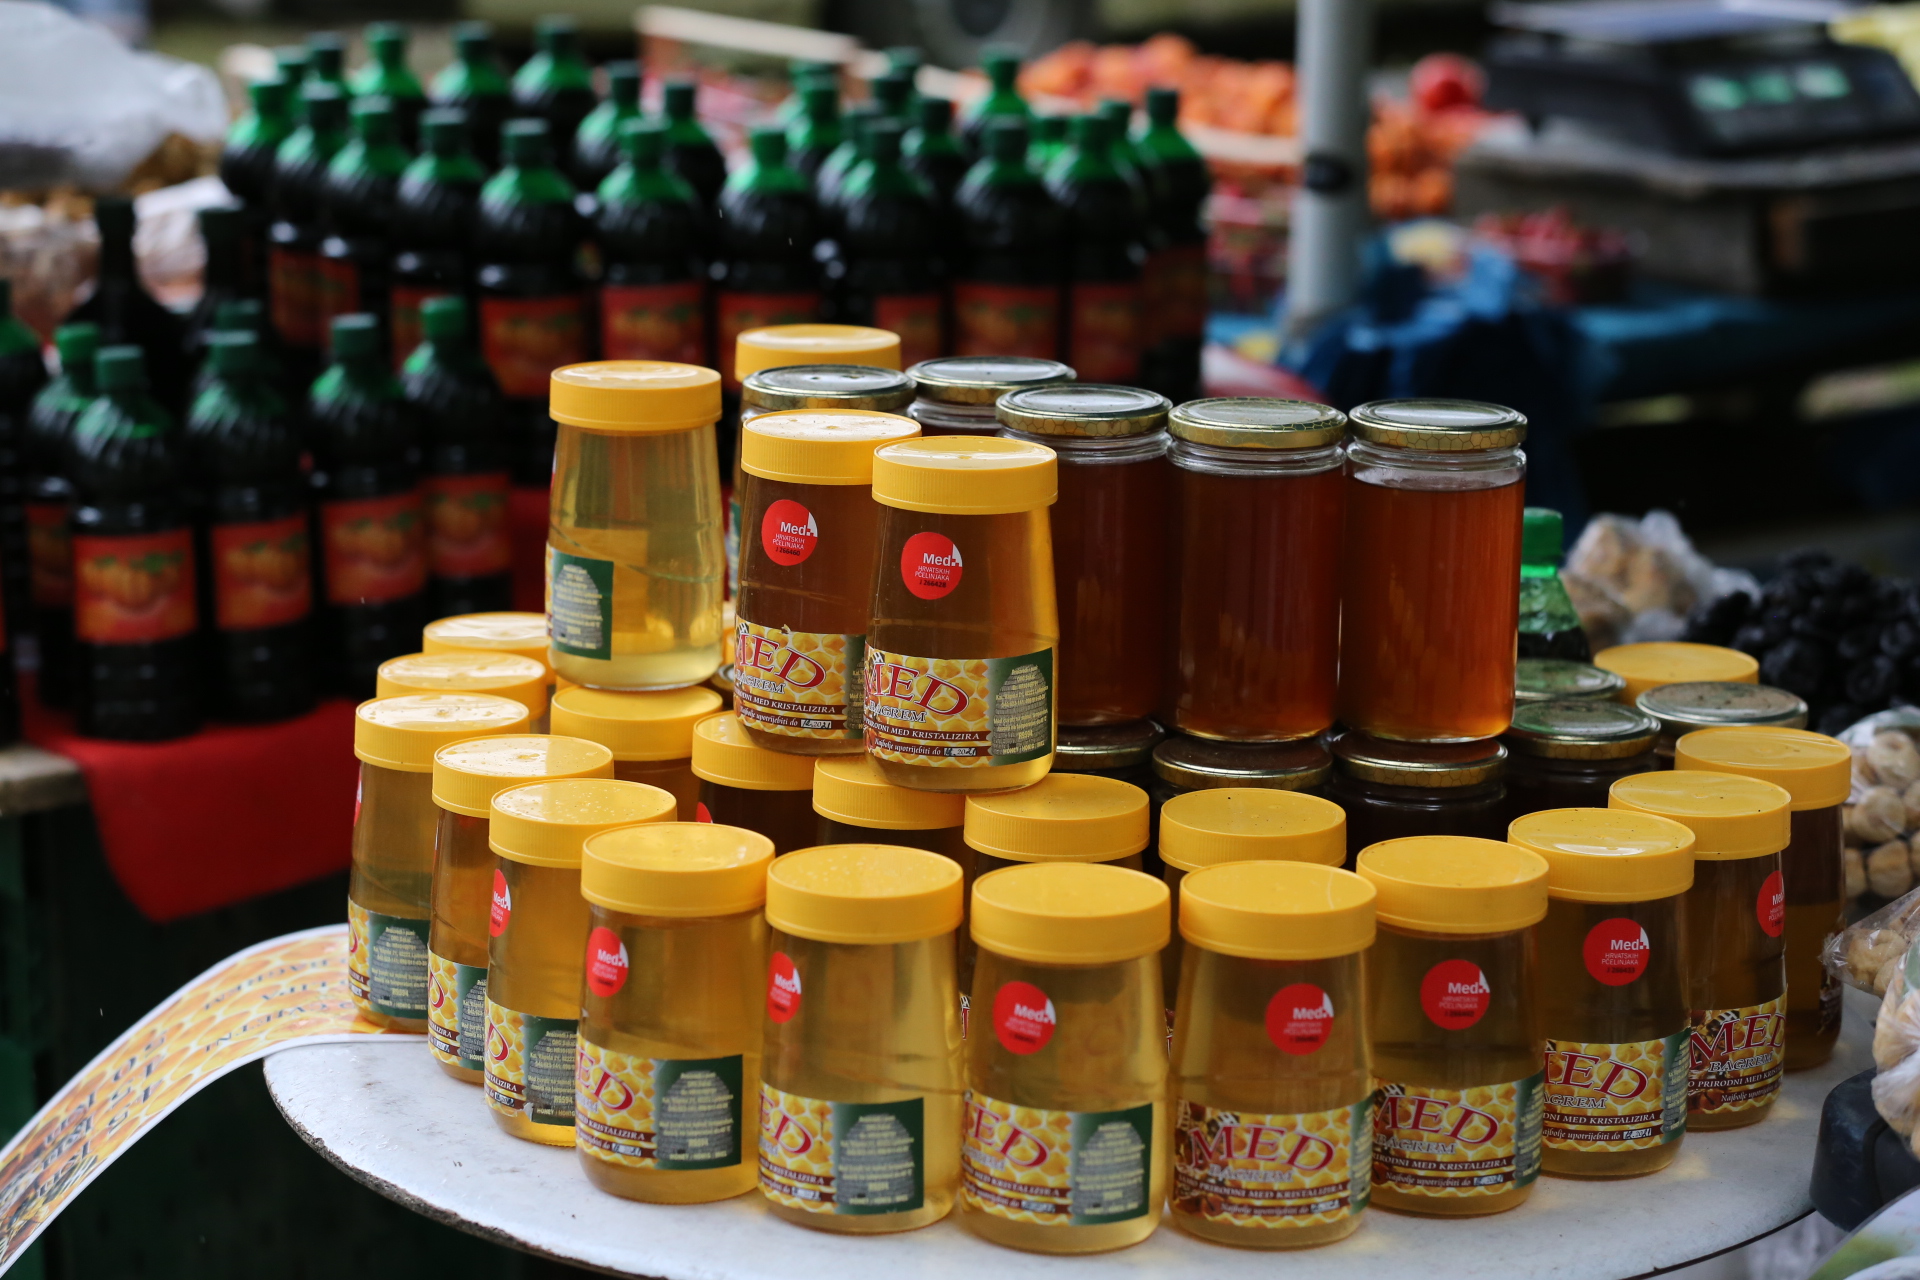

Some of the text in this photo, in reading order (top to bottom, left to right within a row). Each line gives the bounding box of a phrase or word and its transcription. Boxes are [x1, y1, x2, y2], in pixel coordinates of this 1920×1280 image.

[780, 521, 807, 536] Med
[775, 533, 805, 544] HRVATSKIH
[923, 552, 951, 566] Med
[917, 565, 950, 575] HRVATSKIH
[753, 697, 769, 706] MED
[771, 700, 836, 713] KRISTALIZIRA
[869, 699, 927, 723] BAGREM
[789, 715, 799, 726] do
[891, 727, 910, 736] MED
[912, 730, 980, 740] KRISTALIZIRA
[875, 738, 893, 750] Najbolje
[895, 743, 931, 755] upotrijebiti
[932, 746, 941, 755] do
[1611, 939, 1639, 951] Med
[597, 949, 618, 966] Med
[1448, 982, 1479, 994] Med
[1293, 1006, 1322, 1020] Med
[1708, 1051, 1773, 1073] BAGREM
[1698, 1078, 1742, 1088] PRIRODNI
[1745, 1075, 1762, 1084] MED
[1544, 1093, 1608, 1109] AGREM
[1721, 1091, 1747, 1103] Najbolje
[1563, 1115, 1588, 1124] MED
[1589, 1113, 1655, 1125] KRISTALIZIRA
[1542, 1128, 1565, 1139] ajbolje
[1567, 1130, 1610, 1141] upotrijebiti
[1611, 1131, 1621, 1140] do
[1188, 1124, 1336, 1172] MED
[1376, 1133, 1457, 1154] BAGREM
[1411, 1160, 1437, 1170] MED
[1438, 1159, 1507, 1171] KRISTALIZIRA
[1385, 1172, 1415, 1185] Najbolje
[1460, 1177, 1471, 1186] do
[1248, 1190, 1274, 1199] MED
